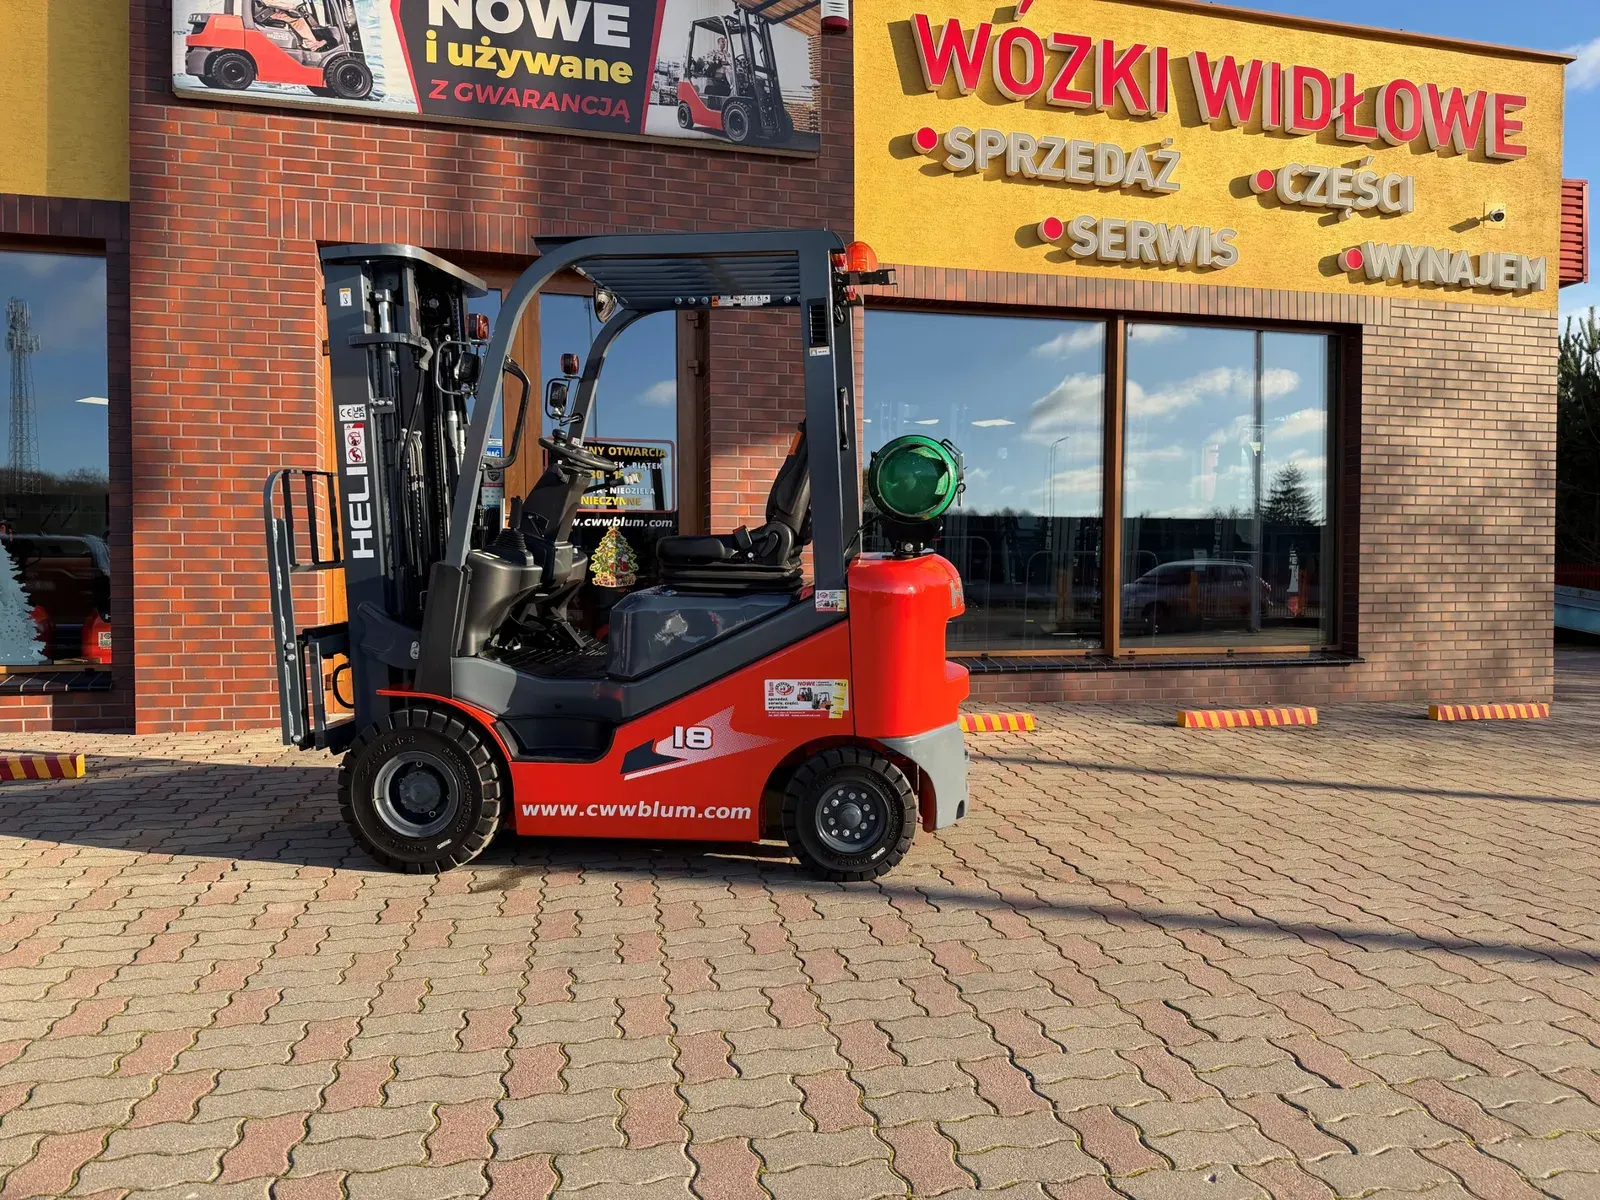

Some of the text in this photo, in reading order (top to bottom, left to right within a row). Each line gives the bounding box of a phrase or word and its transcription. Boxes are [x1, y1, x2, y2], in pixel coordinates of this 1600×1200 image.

[428, 0, 631, 48] NOWE
[425, 29, 634, 85] i używane
[910, 0, 1528, 160] WÓZKI WIDŁOWE
[428, 79, 632, 123] Z GWARANCJĄ
[943, 126, 1181, 194] SPRZEDAŻ
[1276, 155, 1415, 221] CZĘŚCI
[1067, 214, 1239, 270] SERWIS
[1359, 241, 1547, 292] WYNAJEM
[608, 446, 667, 457] OTWARCIA
[632, 461, 663, 471] PIĄTEK
[346, 466, 374, 558] HELI
[580, 496, 642, 506] NIECZYNNE
[610, 487, 655, 495] NIEDZIELA
[673, 725, 713, 750] 18
[521, 801, 752, 820] www.cwwblum.com
